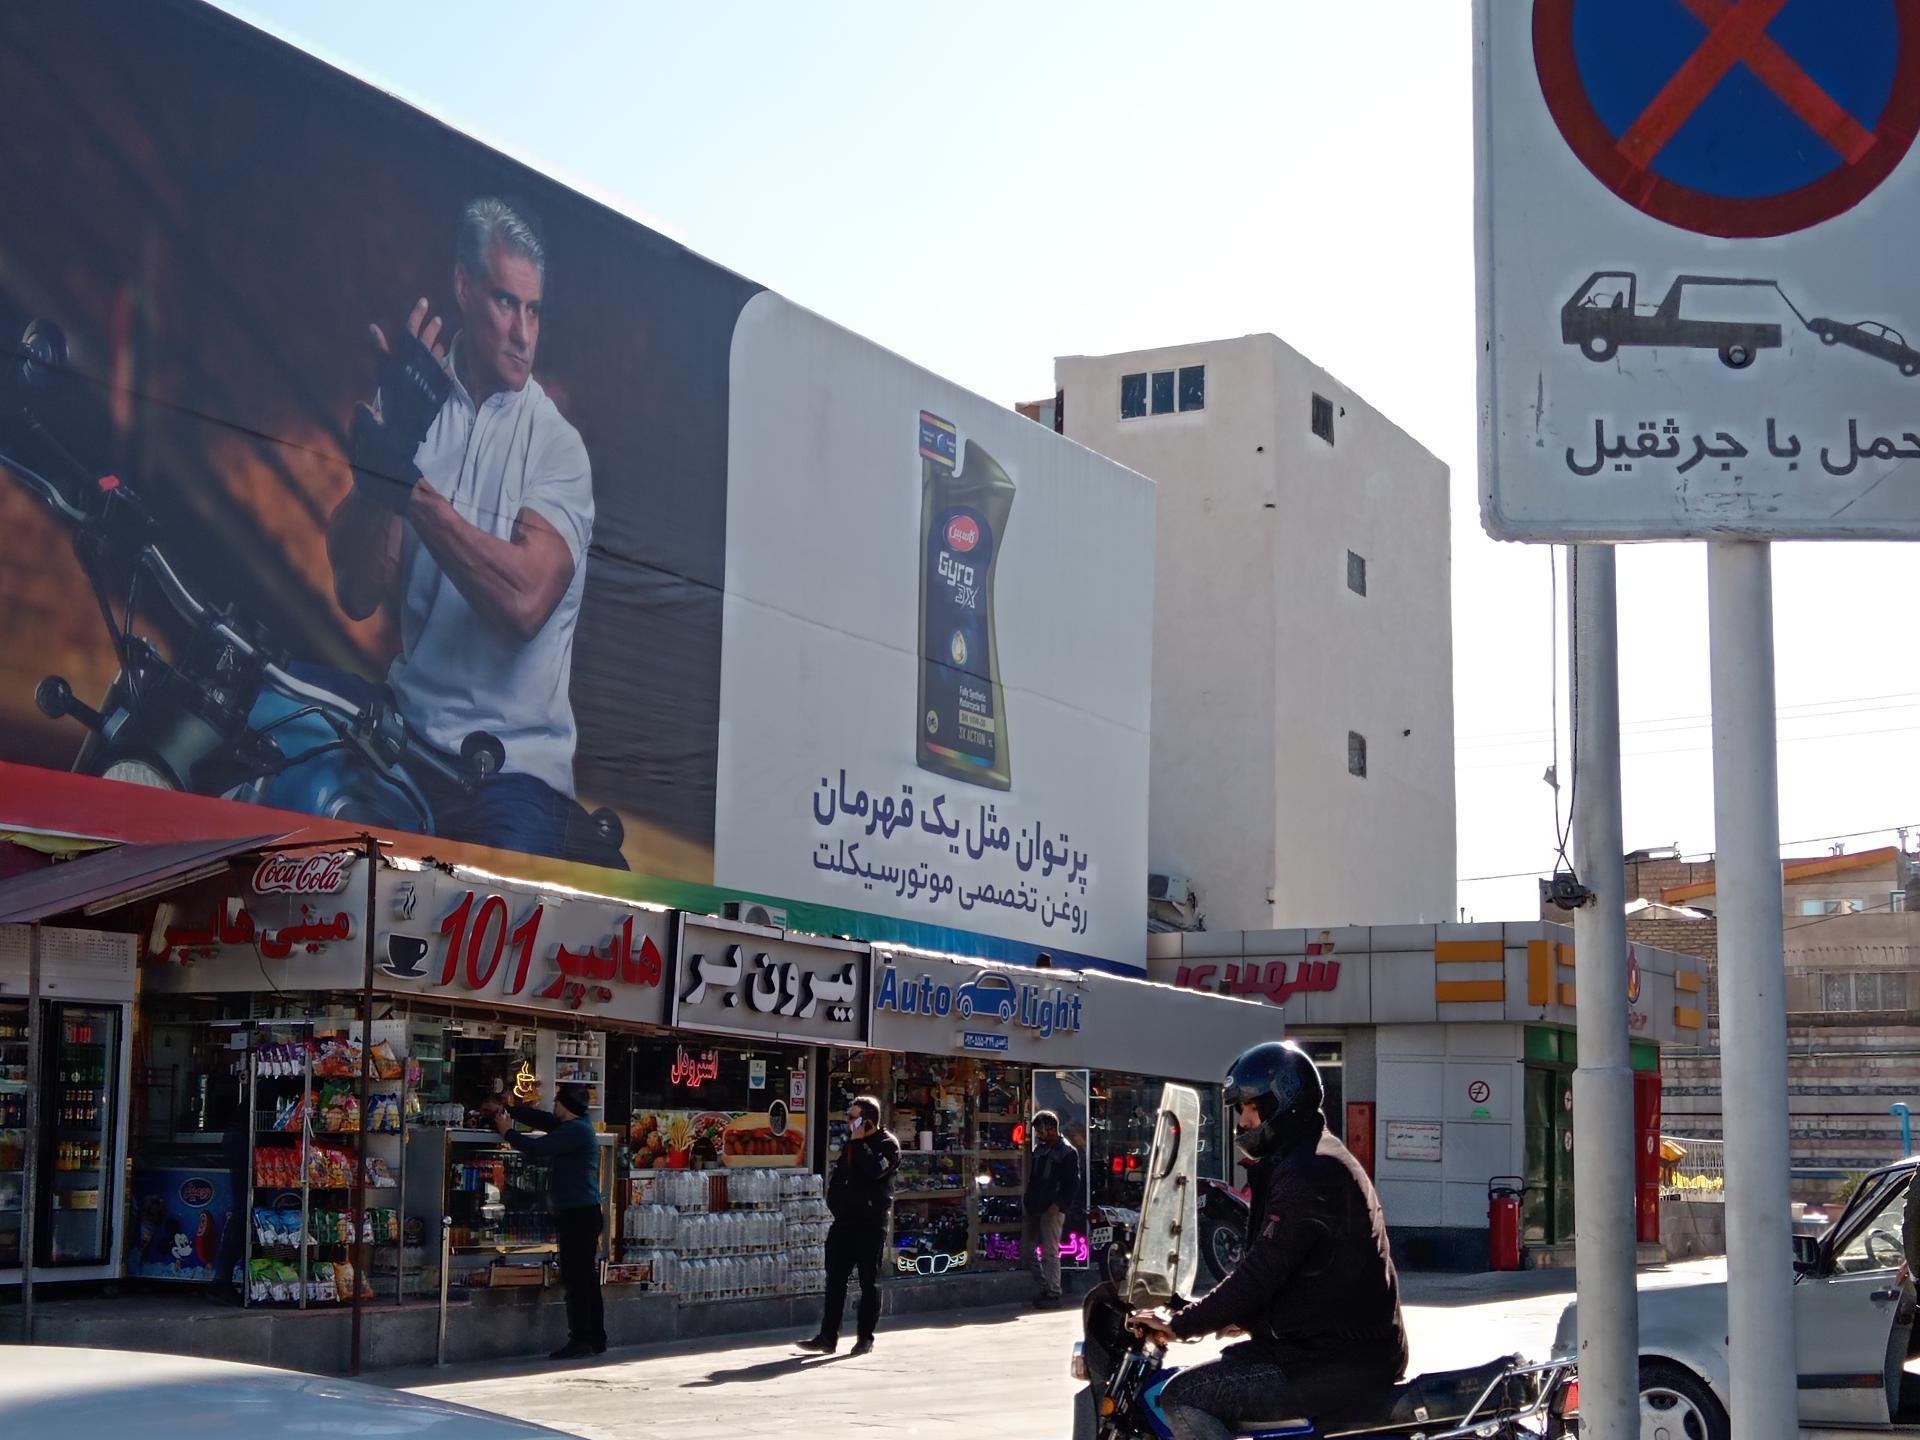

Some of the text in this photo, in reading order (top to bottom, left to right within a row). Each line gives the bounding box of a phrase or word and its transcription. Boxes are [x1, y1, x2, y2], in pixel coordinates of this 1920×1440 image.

[1566, 418, 1748, 476] جرثقیل
[1766, 417, 1801, 472] با
[938, 551, 975, 587] Gyro
[955, 584, 981, 609] 3X
[813, 769, 1088, 894] پرتوان مثل یک قهرمان
[813, 840, 1088, 934] روغن تخصصی موتورسیکلت
[152, 898, 351, 966] مینی هایپر
[436, 889, 663, 1010] هایپر 101
[683, 945, 858, 1021] بیرون بر
[876, 966, 1083, 1040] Auto light
